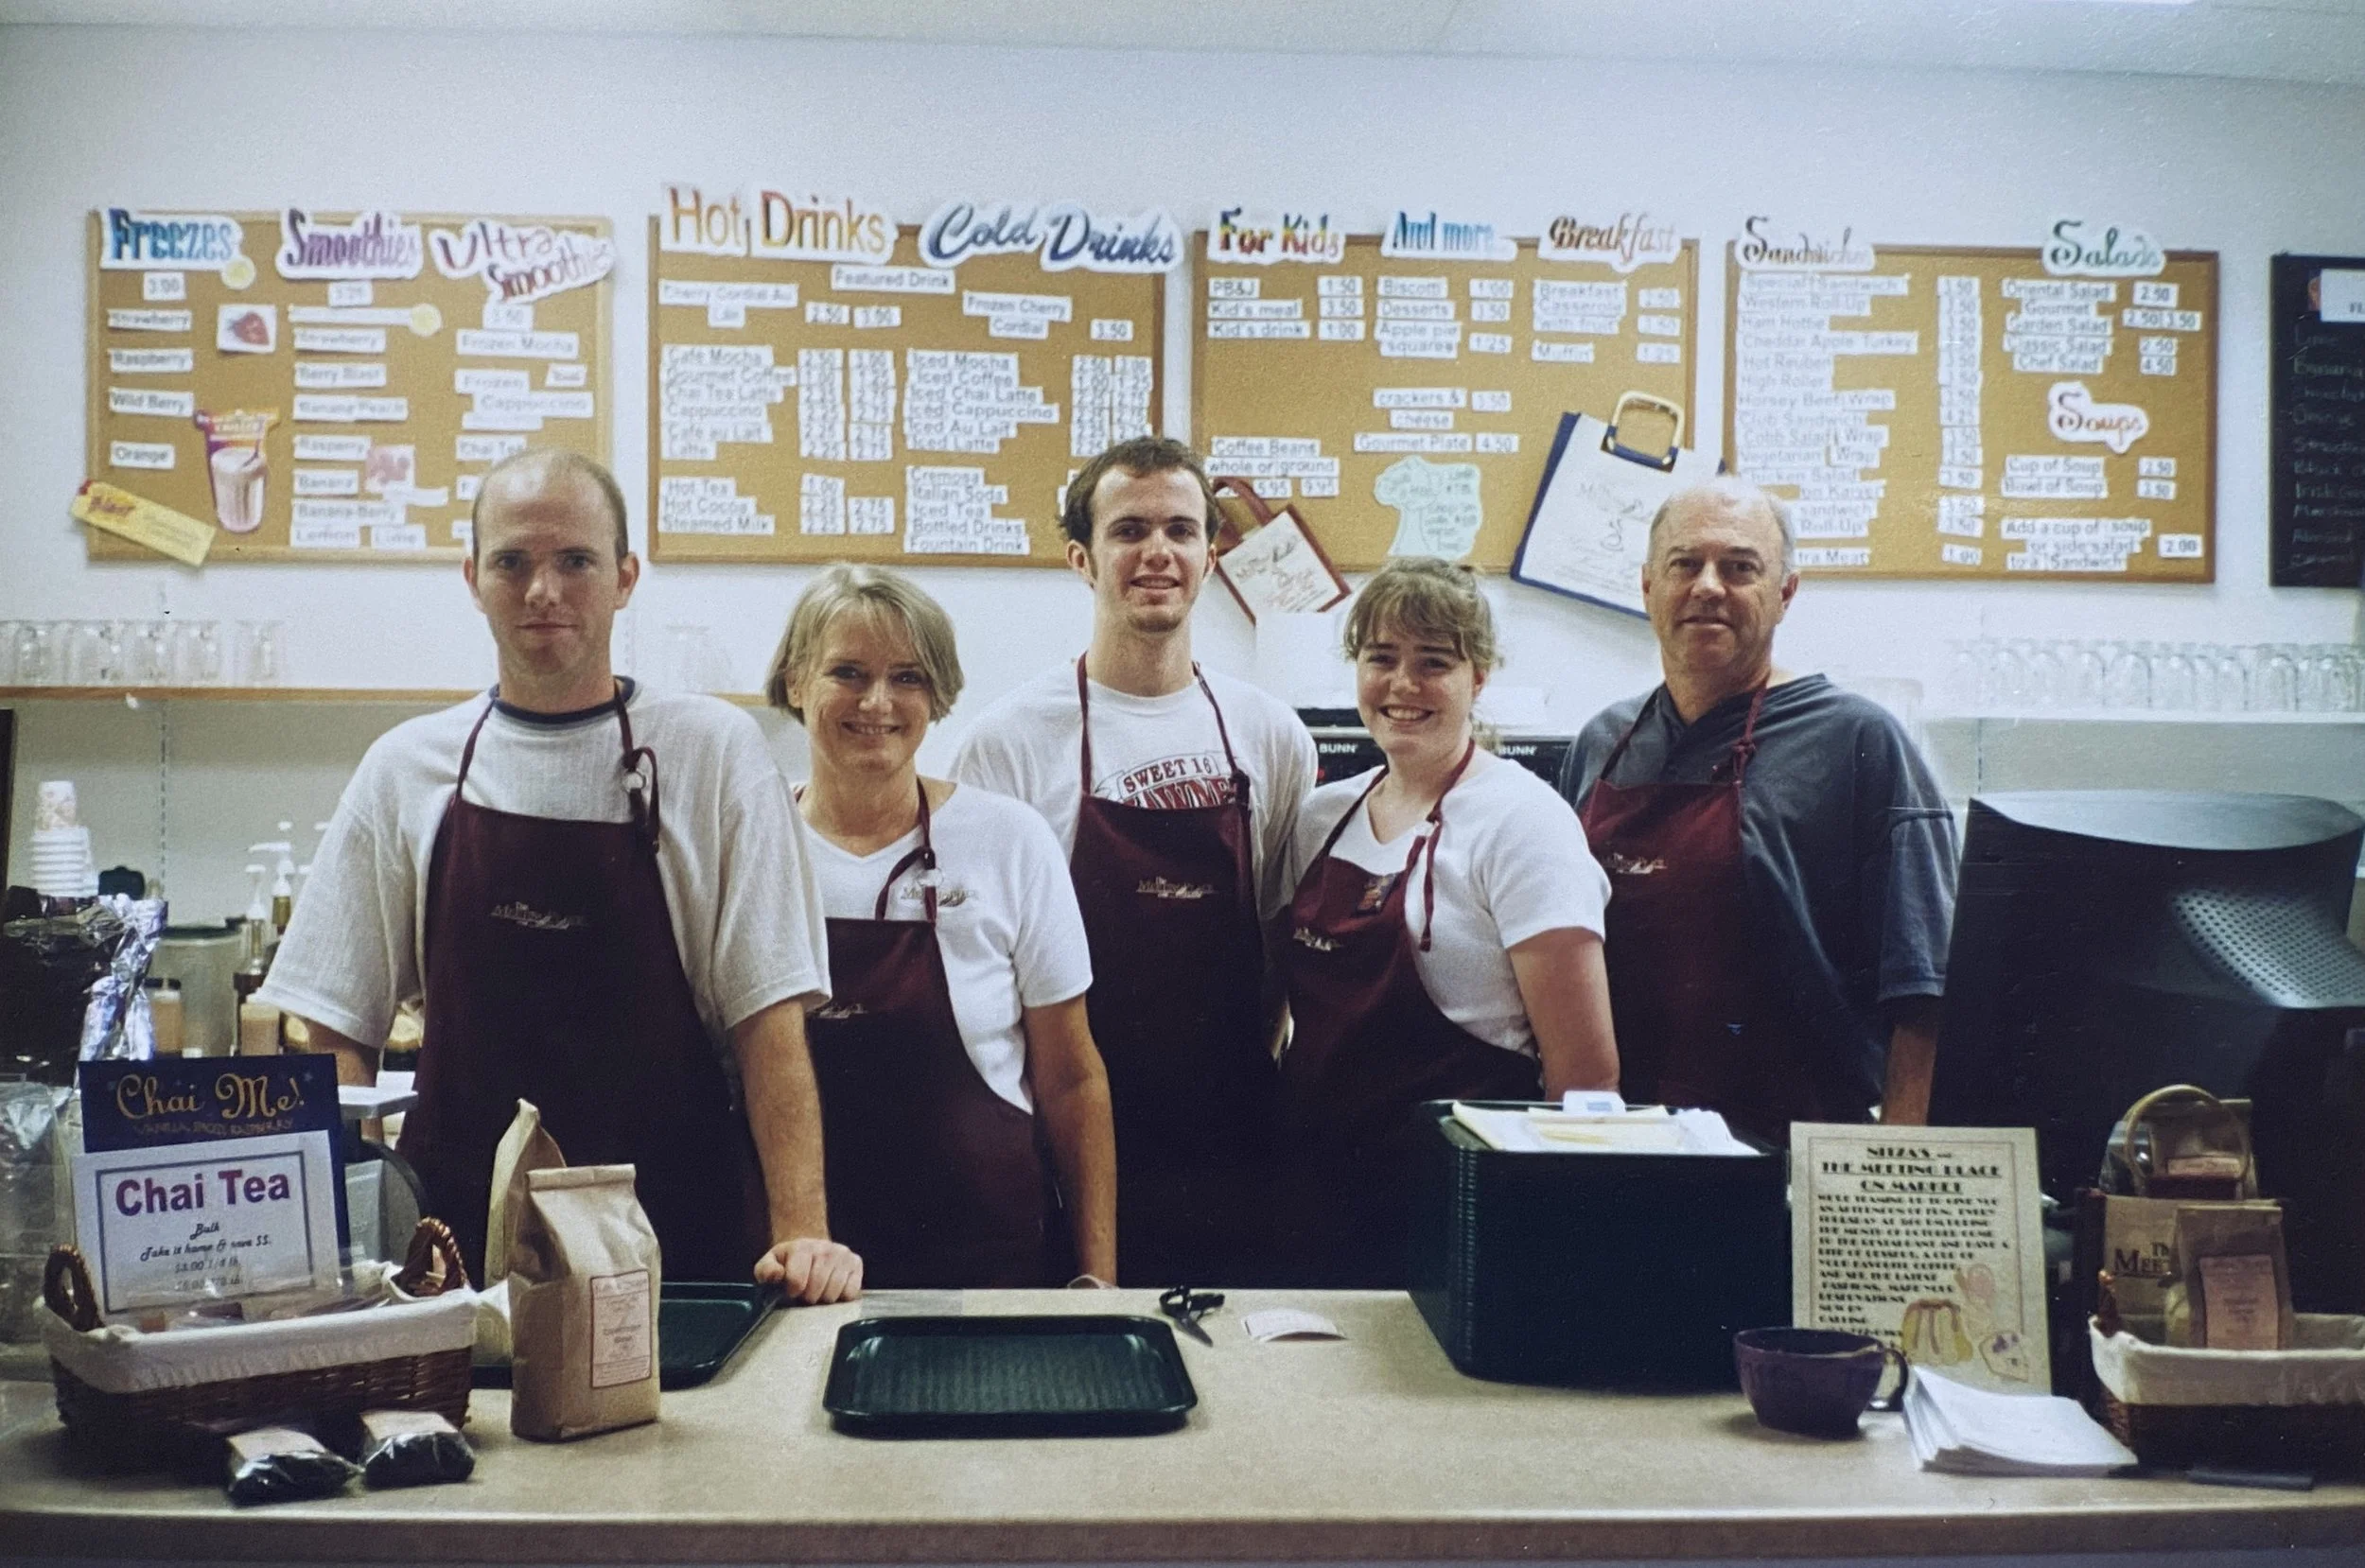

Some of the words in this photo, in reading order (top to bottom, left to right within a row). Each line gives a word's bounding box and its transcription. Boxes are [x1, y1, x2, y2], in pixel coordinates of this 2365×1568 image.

[108, 208, 234, 261] Freezes
[670, 187, 741, 246] Hot
[761, 188, 885, 254] Drinks
[928, 201, 1038, 260] Cold
[1046, 200, 1175, 264] Drinks
[1219, 206, 1273, 255] For
[1282, 212, 1339, 258] Kids
[1393, 211, 1436, 250] And
[287, 207, 418, 269] Smoothies
[437, 220, 553, 270] Ultra
[1549, 212, 1676, 263] Breakfast
[2051, 219, 2161, 268] Salads
[835, 269, 903, 287] Featured
[909, 271, 948, 287] Drink
[1213, 280, 1255, 296] PB&J
[1382, 301, 1448, 316] Desserts
[1394, 411, 1450, 426] cheese
[2058, 392, 2144, 446] Soups
[1215, 440, 1266, 456] Coffee
[1358, 434, 1424, 450] Gourmet
[1428, 435, 1468, 450] Plate
[1209, 459, 1253, 473] whole
[1277, 460, 1336, 478] ground
[1319, 742, 1358, 754] BUNN
[1498, 745, 1538, 757] BUNN
[1123, 758, 1187, 793] SWEET
[1191, 756, 1213, 775] 16
[116, 1073, 205, 1120] Chai
[215, 1071, 305, 1119] Me!
[1861, 1163, 1937, 1176] MEETING
[1943, 1165, 2001, 1177] PLACE
[115, 1173, 204, 1217] Chai
[218, 1169, 291, 1206] Tea
[1891, 1181, 1962, 1193] MARKET
[189, 1221, 220, 1241] Bulk
[2150, 1240, 2171, 1257] Th
